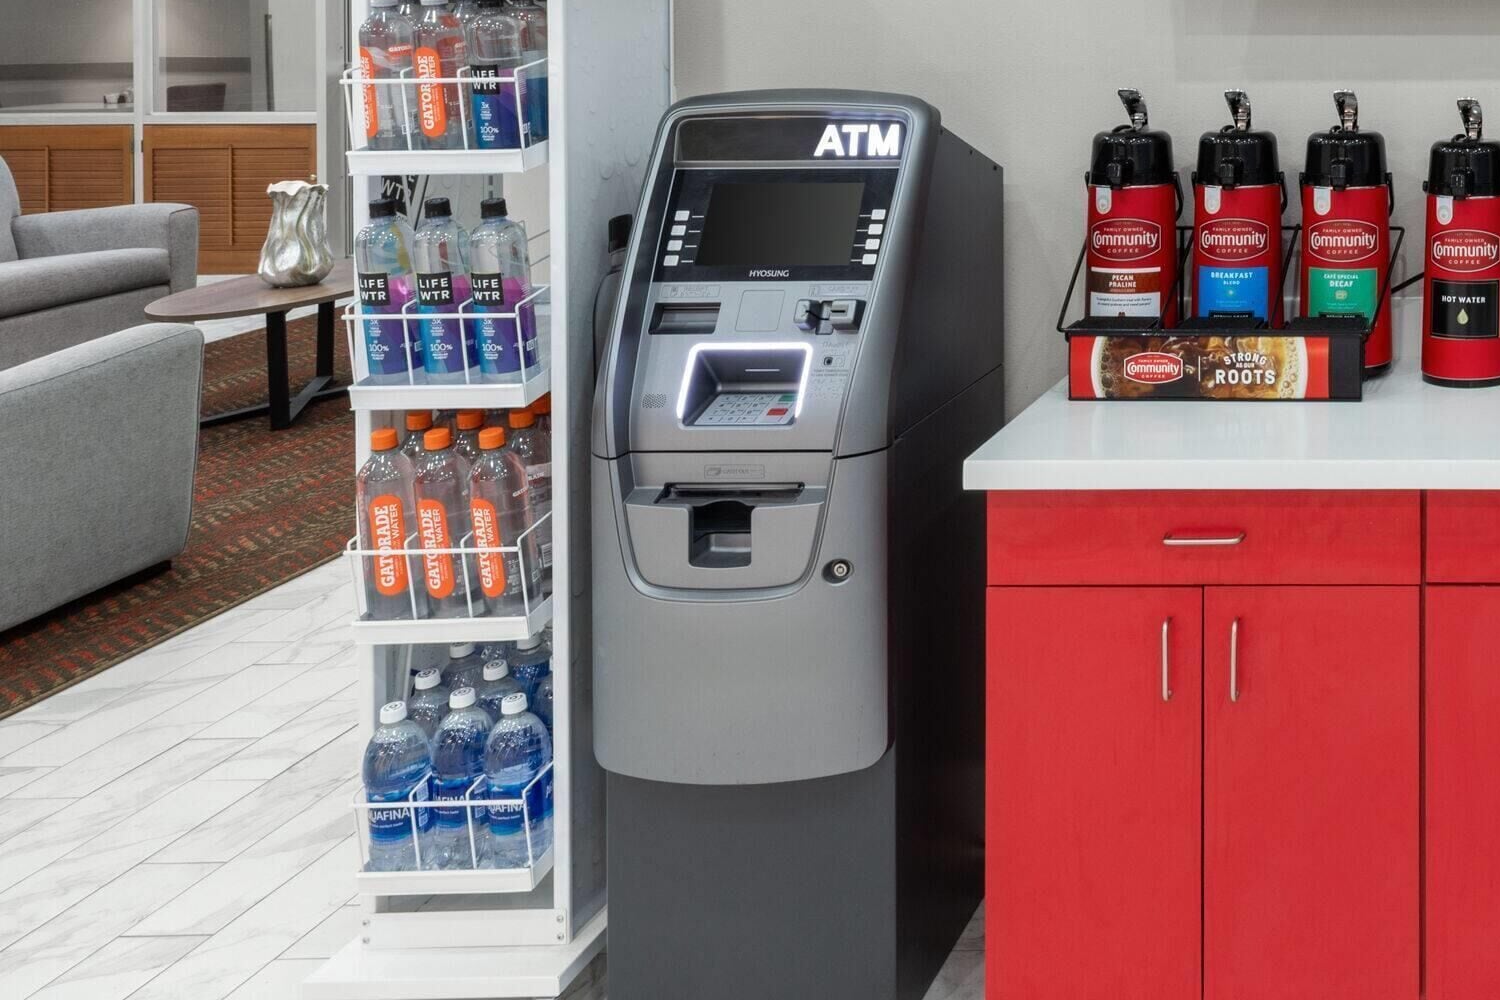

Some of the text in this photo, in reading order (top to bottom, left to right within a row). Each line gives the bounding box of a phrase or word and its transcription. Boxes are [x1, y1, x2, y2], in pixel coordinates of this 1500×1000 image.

[813, 124, 900, 157] ATM
[1093, 230, 1158, 248] Community
[1201, 230, 1266, 248] Community
[1311, 232, 1376, 249] Community
[1433, 241, 1498, 260] Community
[749, 269, 790, 278] HYOSUNG
[360, 279, 385, 288] LIFE
[419, 278, 449, 289] LIFE
[473, 279, 499, 289] LIFE
[361, 291, 386, 301] WTR
[420, 290, 450, 301] WTR
[473, 291, 501, 301] WTR
[1441, 295, 1486, 304] HOT WATER
[430, 343, 453, 352] 100%
[1223, 352, 1267, 365] STRONG
[1127, 361, 1180, 375] Community
[1215, 369, 1276, 384] ROOTS
[389, 503, 400, 539] WATER
[432, 508, 444, 543] WATER
[483, 508, 494, 543] WATER
